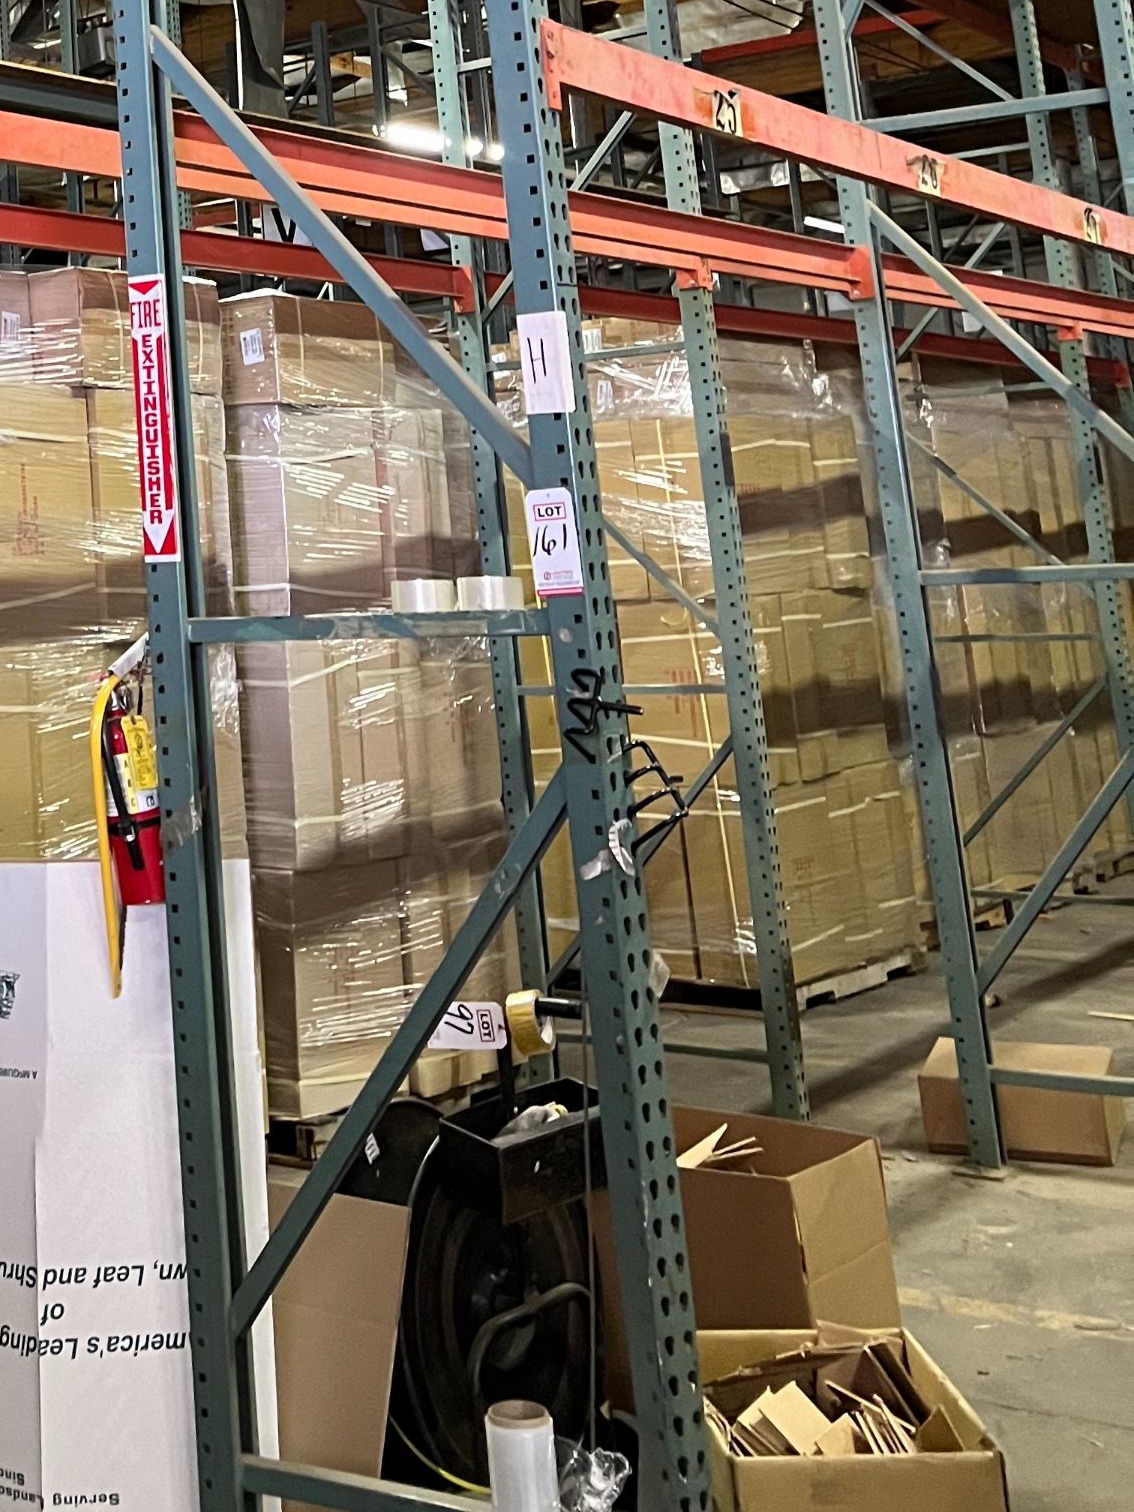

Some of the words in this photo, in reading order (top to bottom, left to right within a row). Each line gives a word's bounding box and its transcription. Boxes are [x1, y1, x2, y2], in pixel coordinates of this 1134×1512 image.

[130, 299, 162, 329] FIRE
[527, 337, 547, 384] H
[141, 334, 163, 525] EXTINGUISHER
[537, 506, 562, 518] LOT
[533, 523, 567, 557] 161
[480, 1013, 492, 1038] LOT
[32, 1071, 38, 1080] A
[42, 1266, 86, 1290] and
[93, 1265, 145, 1289] Leaf
[40, 1303, 65, 1326] of
[0, 1325, 78, 1360] Leading
[87, 1331, 187, 1359] merica's
[52, 1492, 120, 1507] Serving
